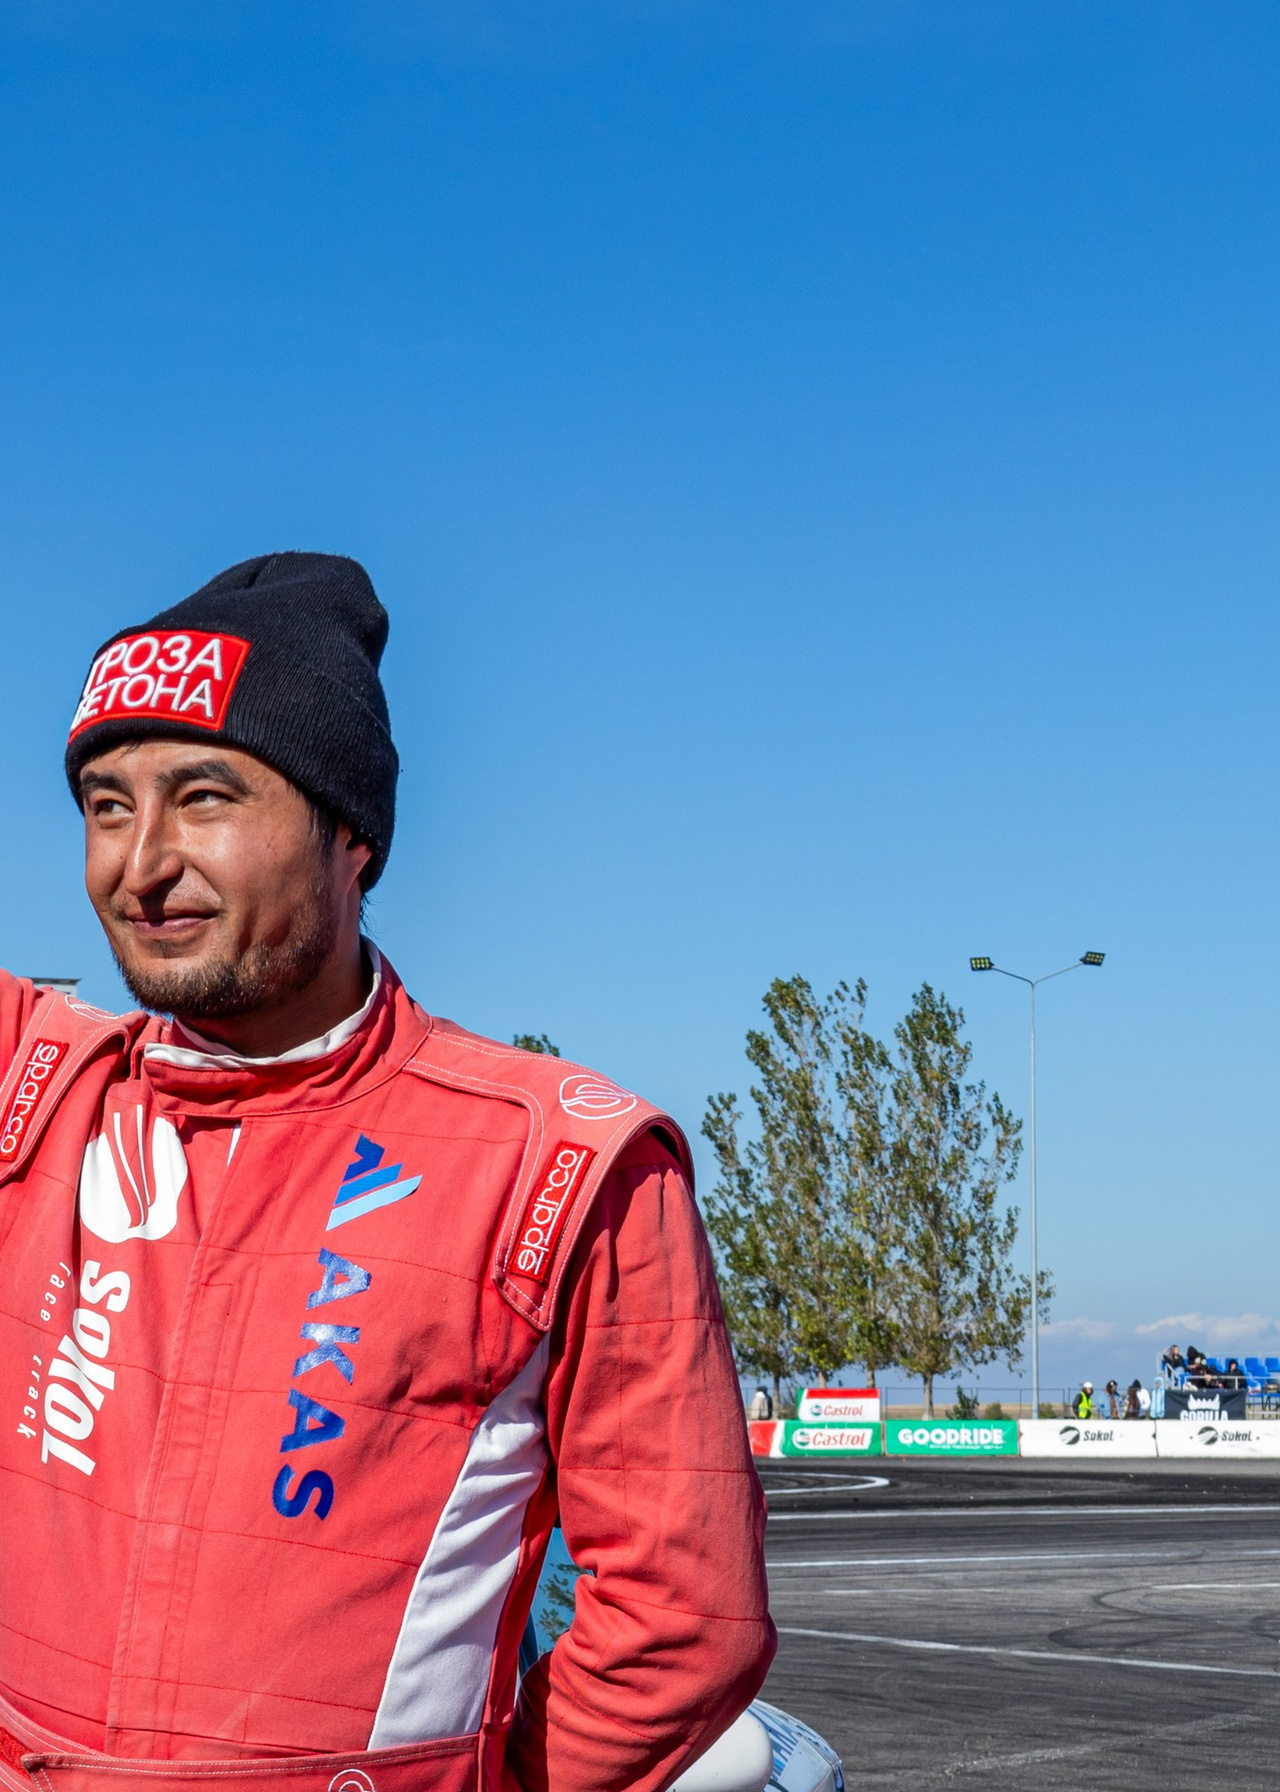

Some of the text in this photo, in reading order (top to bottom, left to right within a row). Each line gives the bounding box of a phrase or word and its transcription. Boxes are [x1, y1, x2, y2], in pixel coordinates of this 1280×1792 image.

[517, 1148, 586, 1275] sparco
[16, 1260, 72, 1439] race track
[271, 1247, 372, 1521] AKAS
[823, 1404, 863, 1416] Castrol
[813, 1432, 866, 1446] Castrol
[897, 1427, 1004, 1445] GOODRIDE
[1083, 1430, 1114, 1442] Sokol
[1221, 1430, 1253, 1442] Sokol
